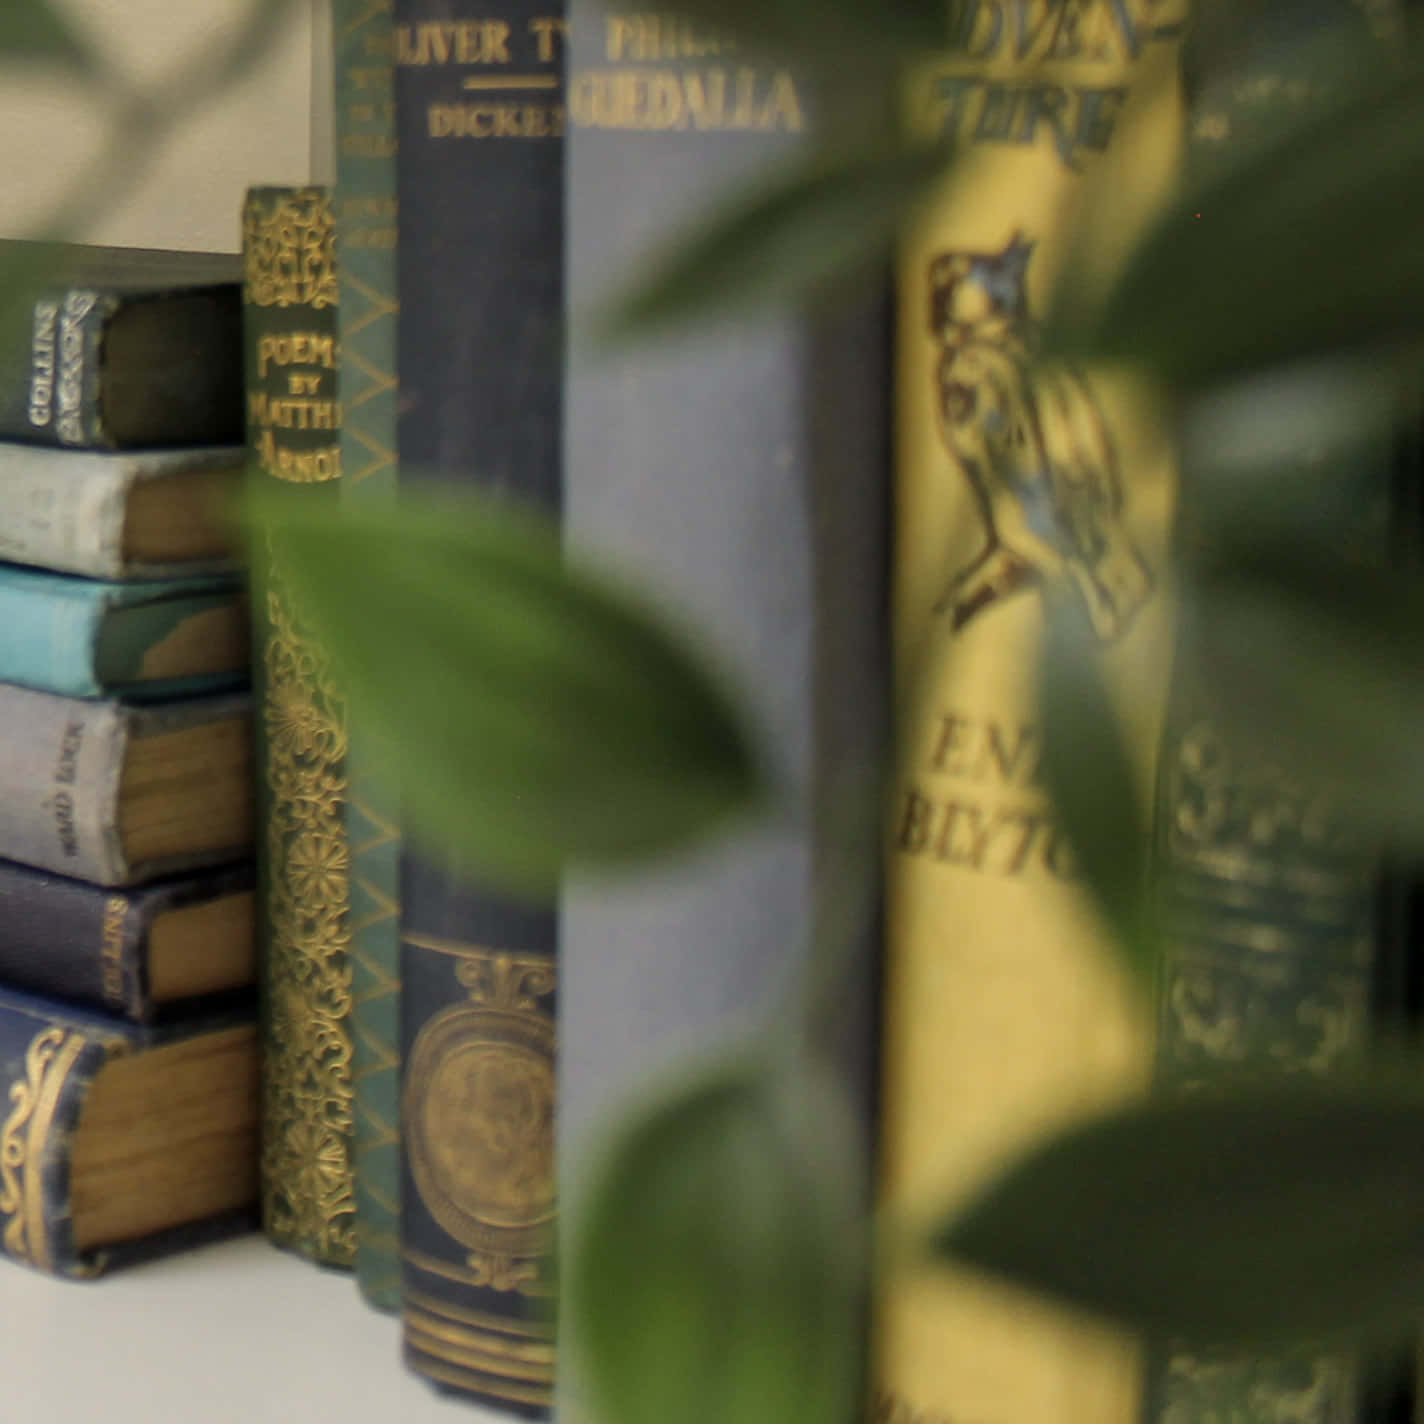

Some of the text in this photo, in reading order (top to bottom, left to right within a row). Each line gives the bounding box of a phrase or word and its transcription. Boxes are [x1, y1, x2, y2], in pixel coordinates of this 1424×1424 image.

[395, 18, 511, 65] LIVER
[605, 13, 735, 62] PHIL
[427, 103, 567, 139] DICKE
[28, 301, 59, 427] COLLINS
[257, 332, 341, 379] POEM
[248, 391, 343, 430] MATTH
[254, 430, 343, 483] ARNO
[103, 896, 129, 1001] LLINS
